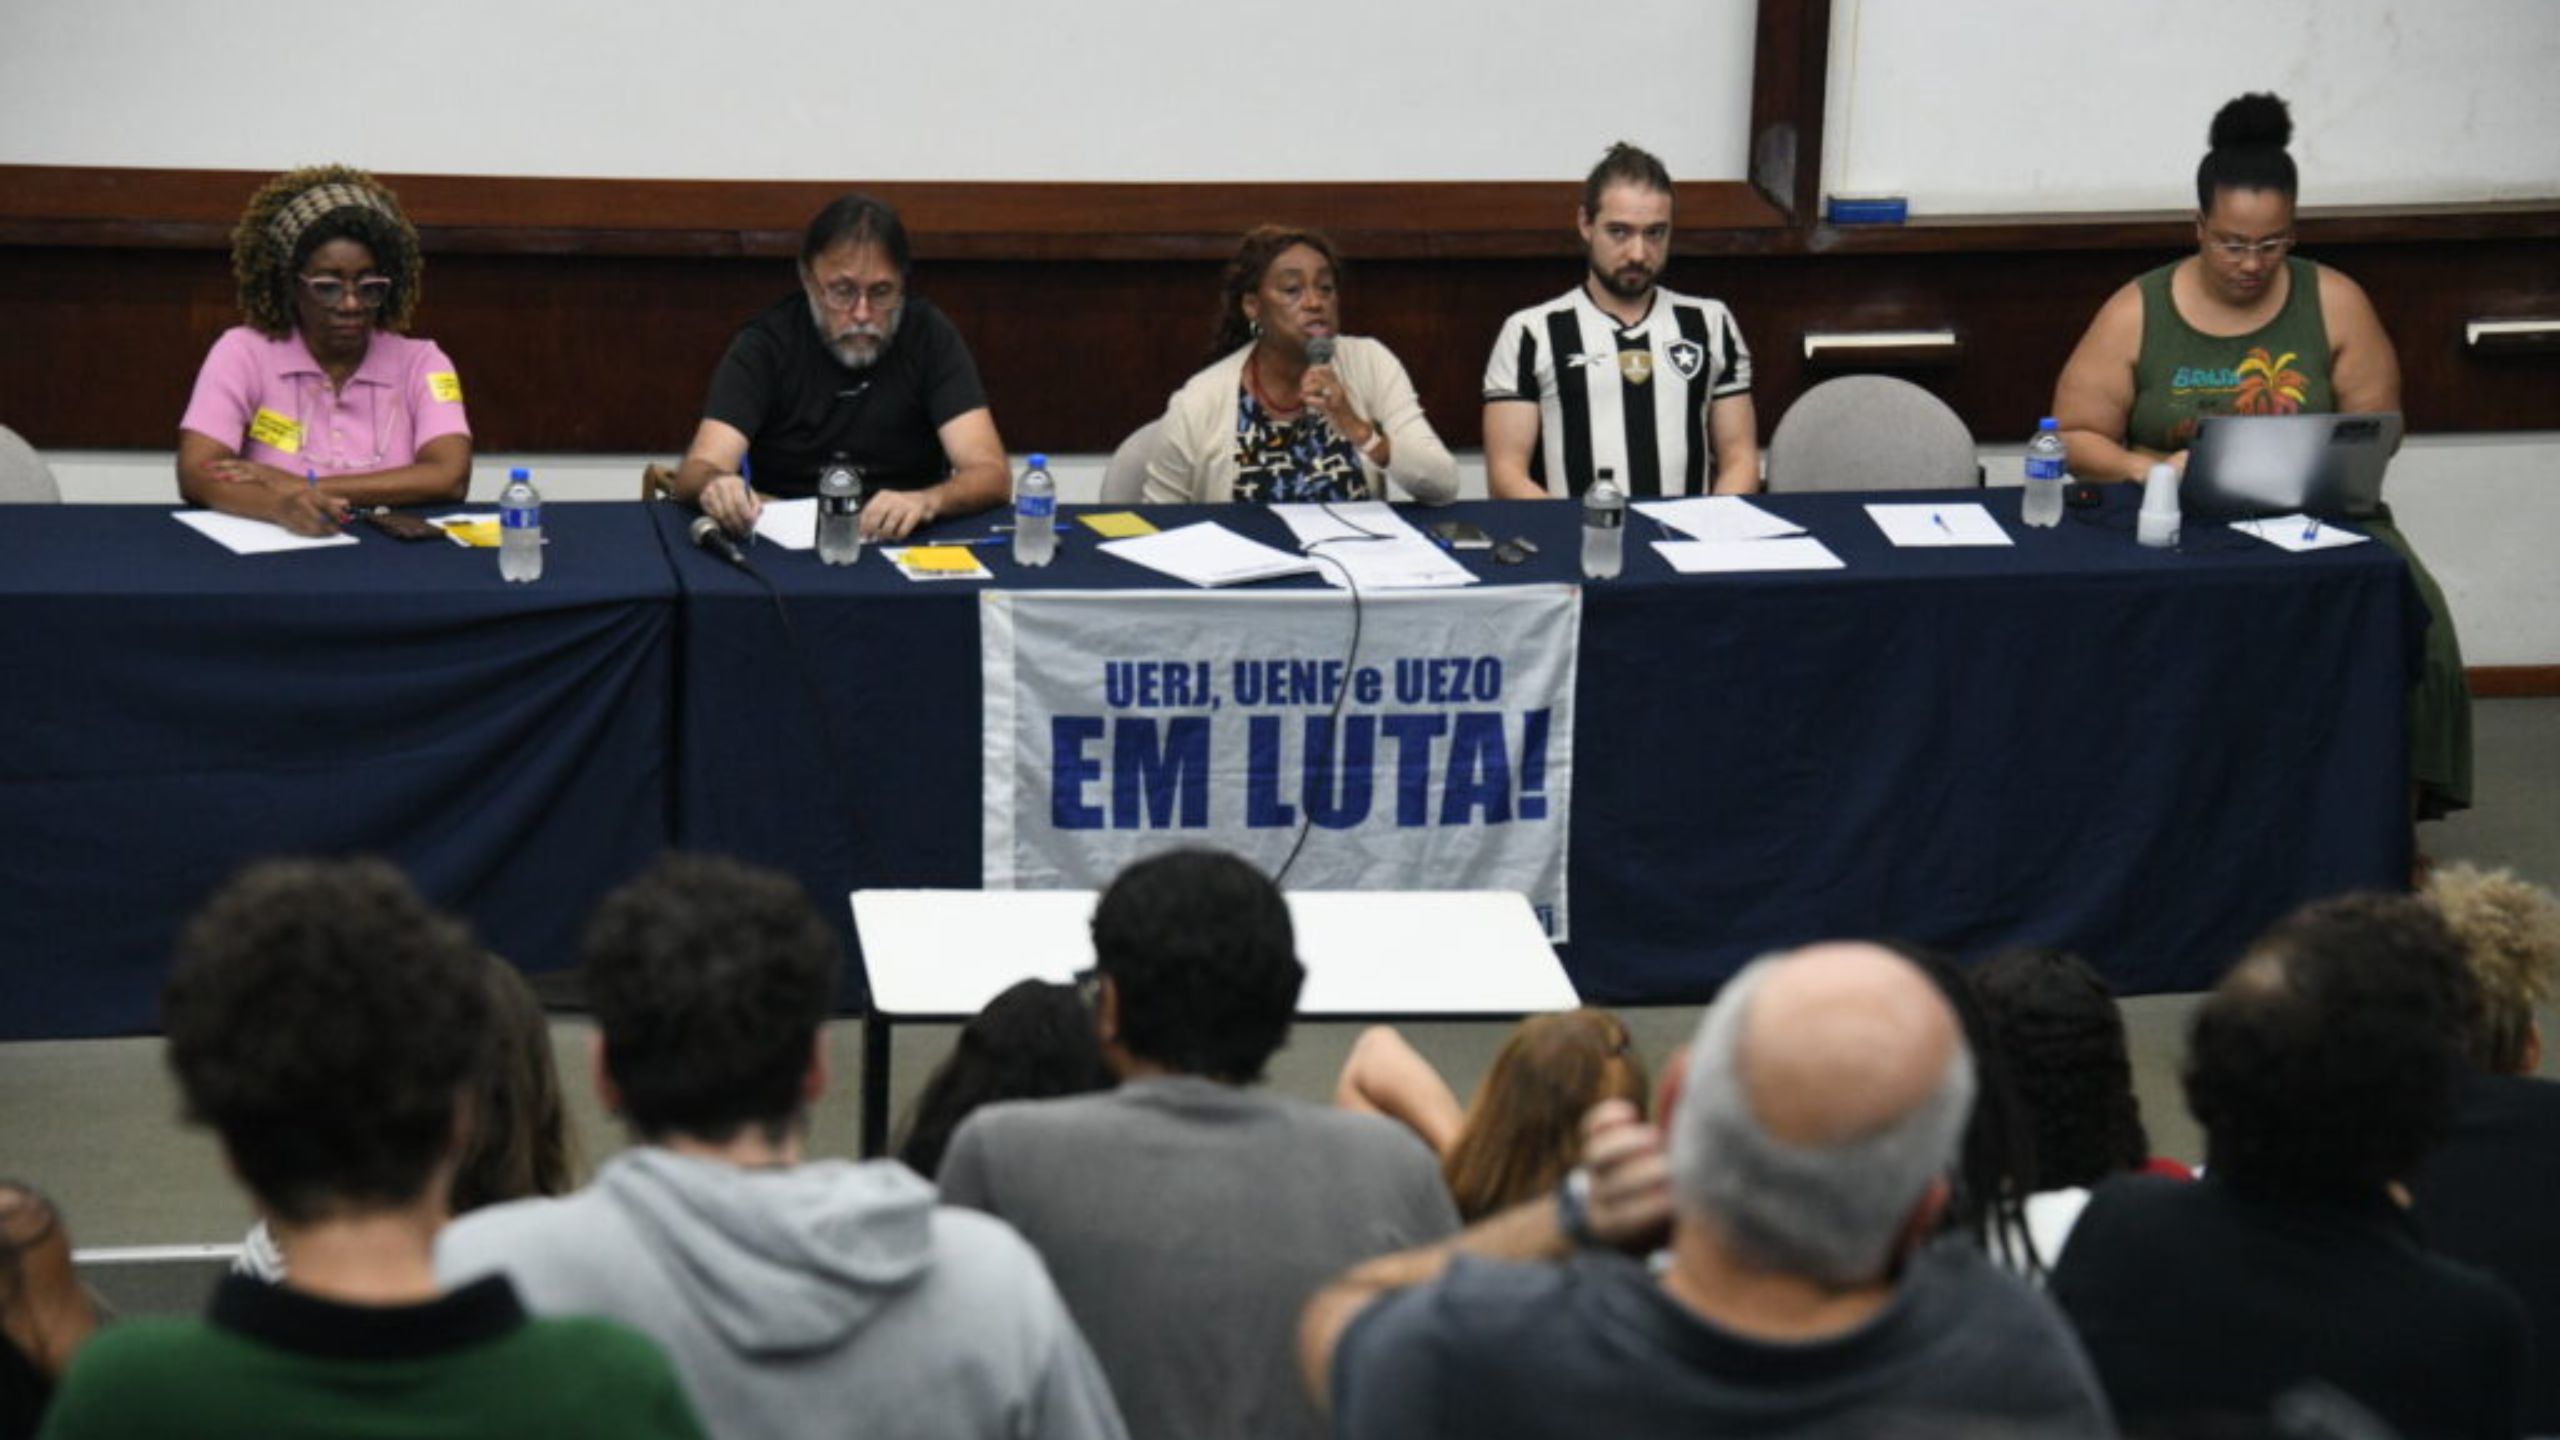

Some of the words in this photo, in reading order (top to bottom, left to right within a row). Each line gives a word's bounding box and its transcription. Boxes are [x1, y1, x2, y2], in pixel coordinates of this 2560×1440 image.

[1105, 660, 1222, 711] UERJ,
[1232, 659, 1343, 707] UENF
[1354, 665, 1384, 707] e
[1394, 655, 1503, 707] UEZO
[1051, 714, 1211, 831] EM
[1246, 706, 1552, 831] LUTA!
